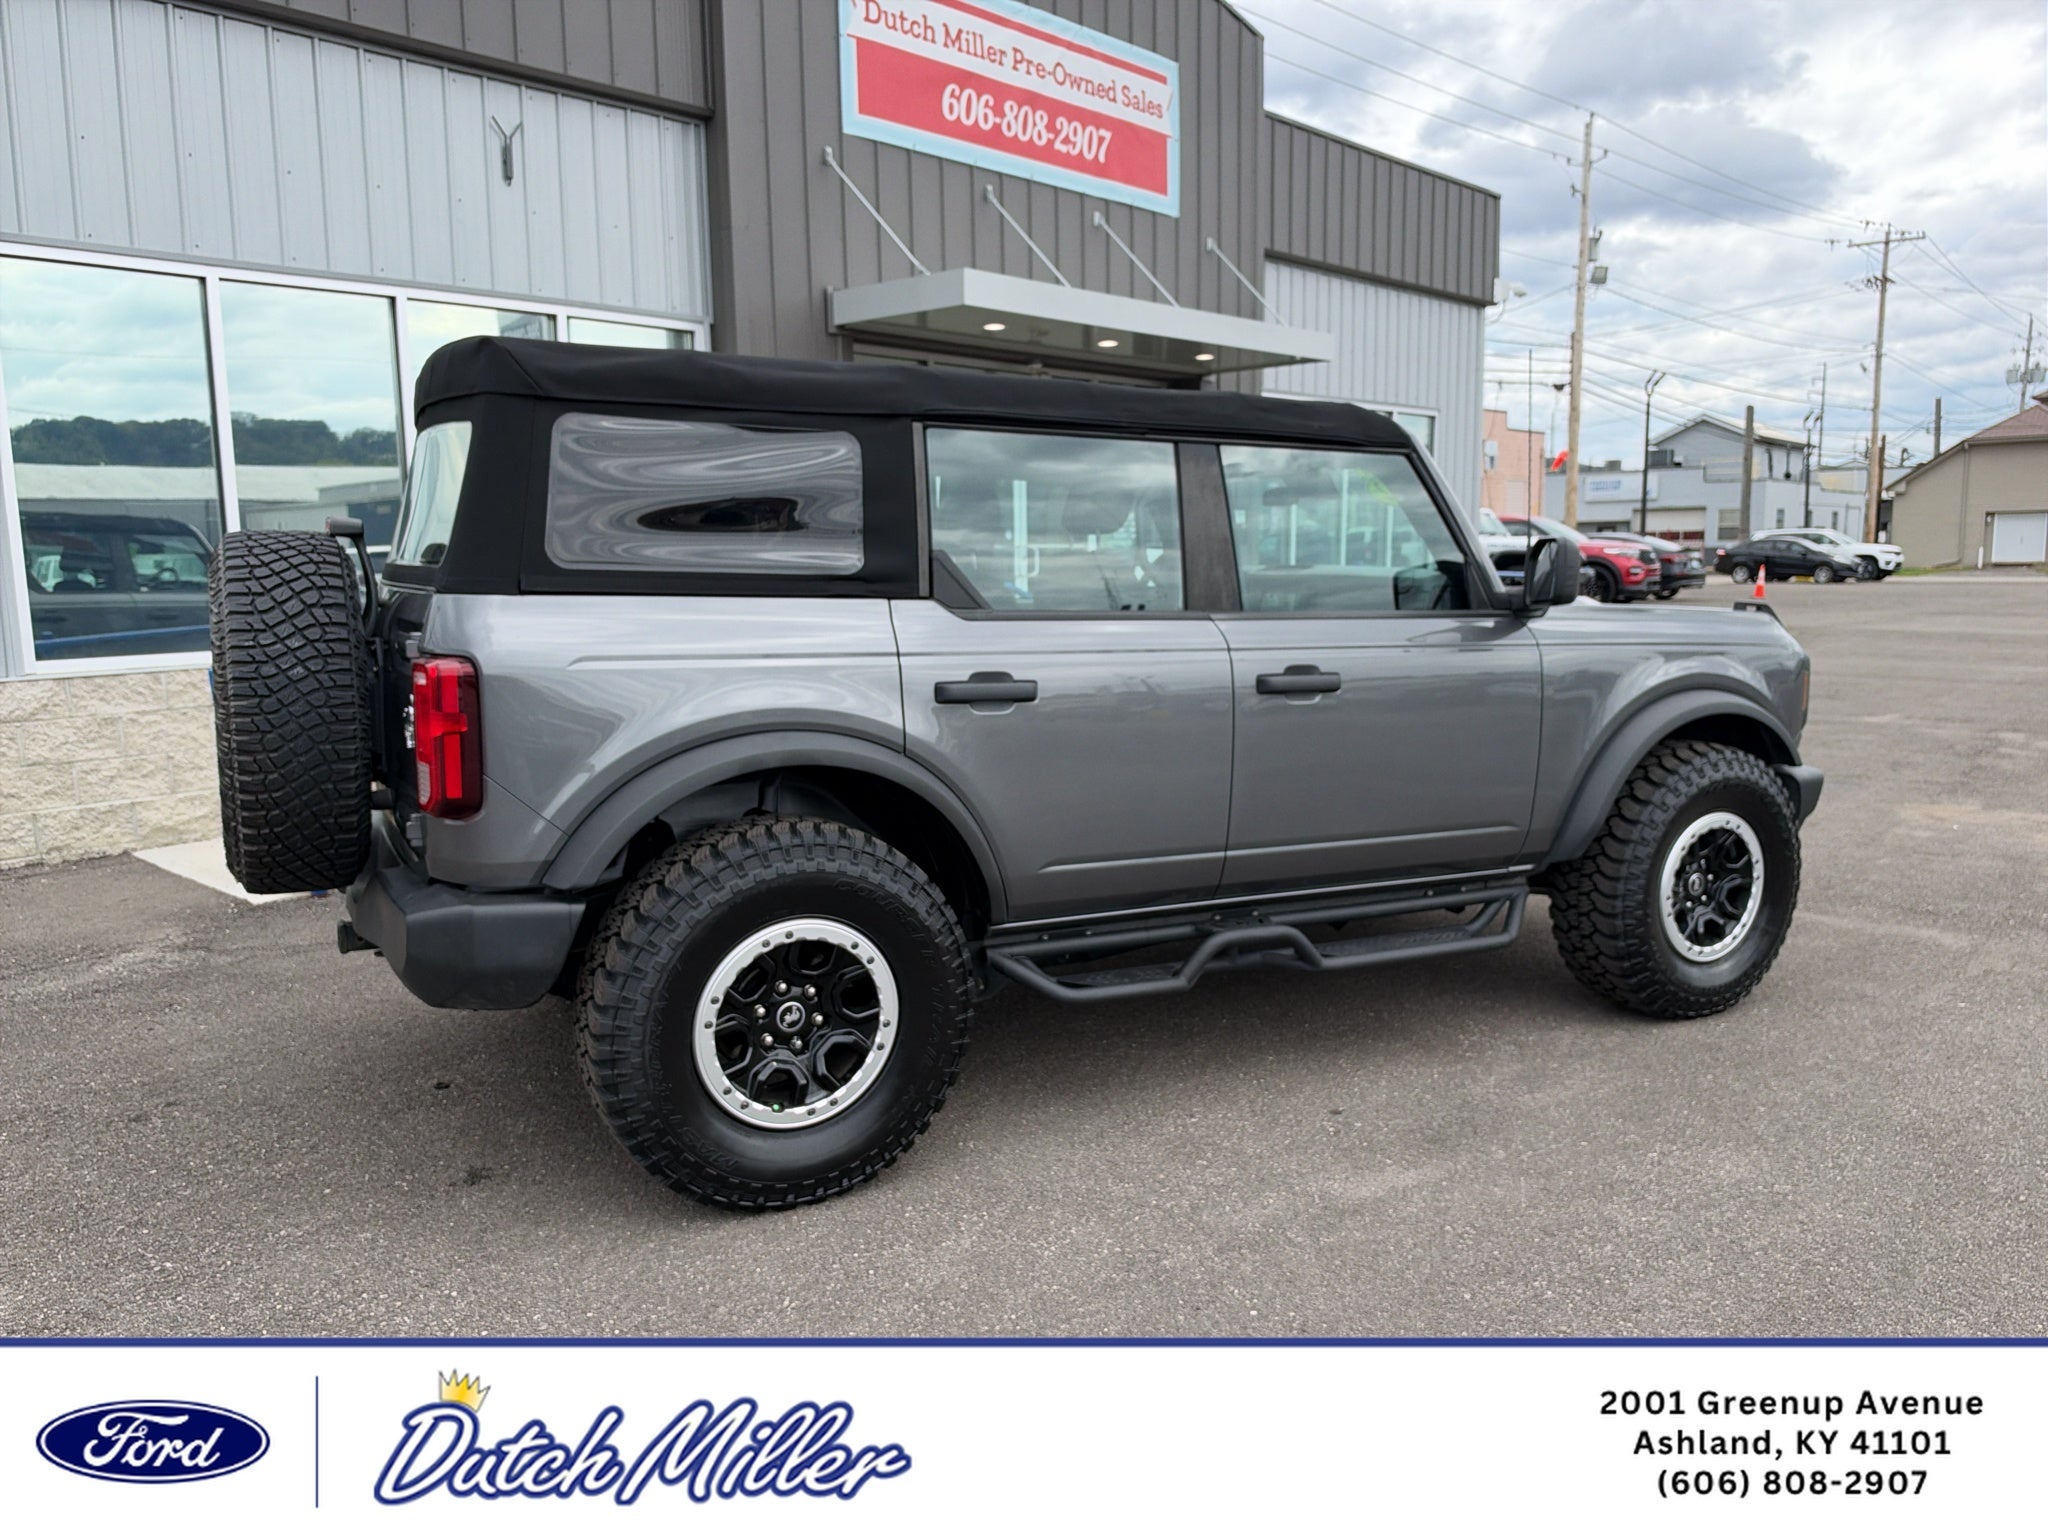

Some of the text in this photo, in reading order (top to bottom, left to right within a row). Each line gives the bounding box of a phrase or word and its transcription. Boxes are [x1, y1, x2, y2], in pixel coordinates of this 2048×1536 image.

[863, 0, 1164, 120] Dutch Miller Pre-Owned Sales
[941, 83, 1112, 164] 606-808-2907
